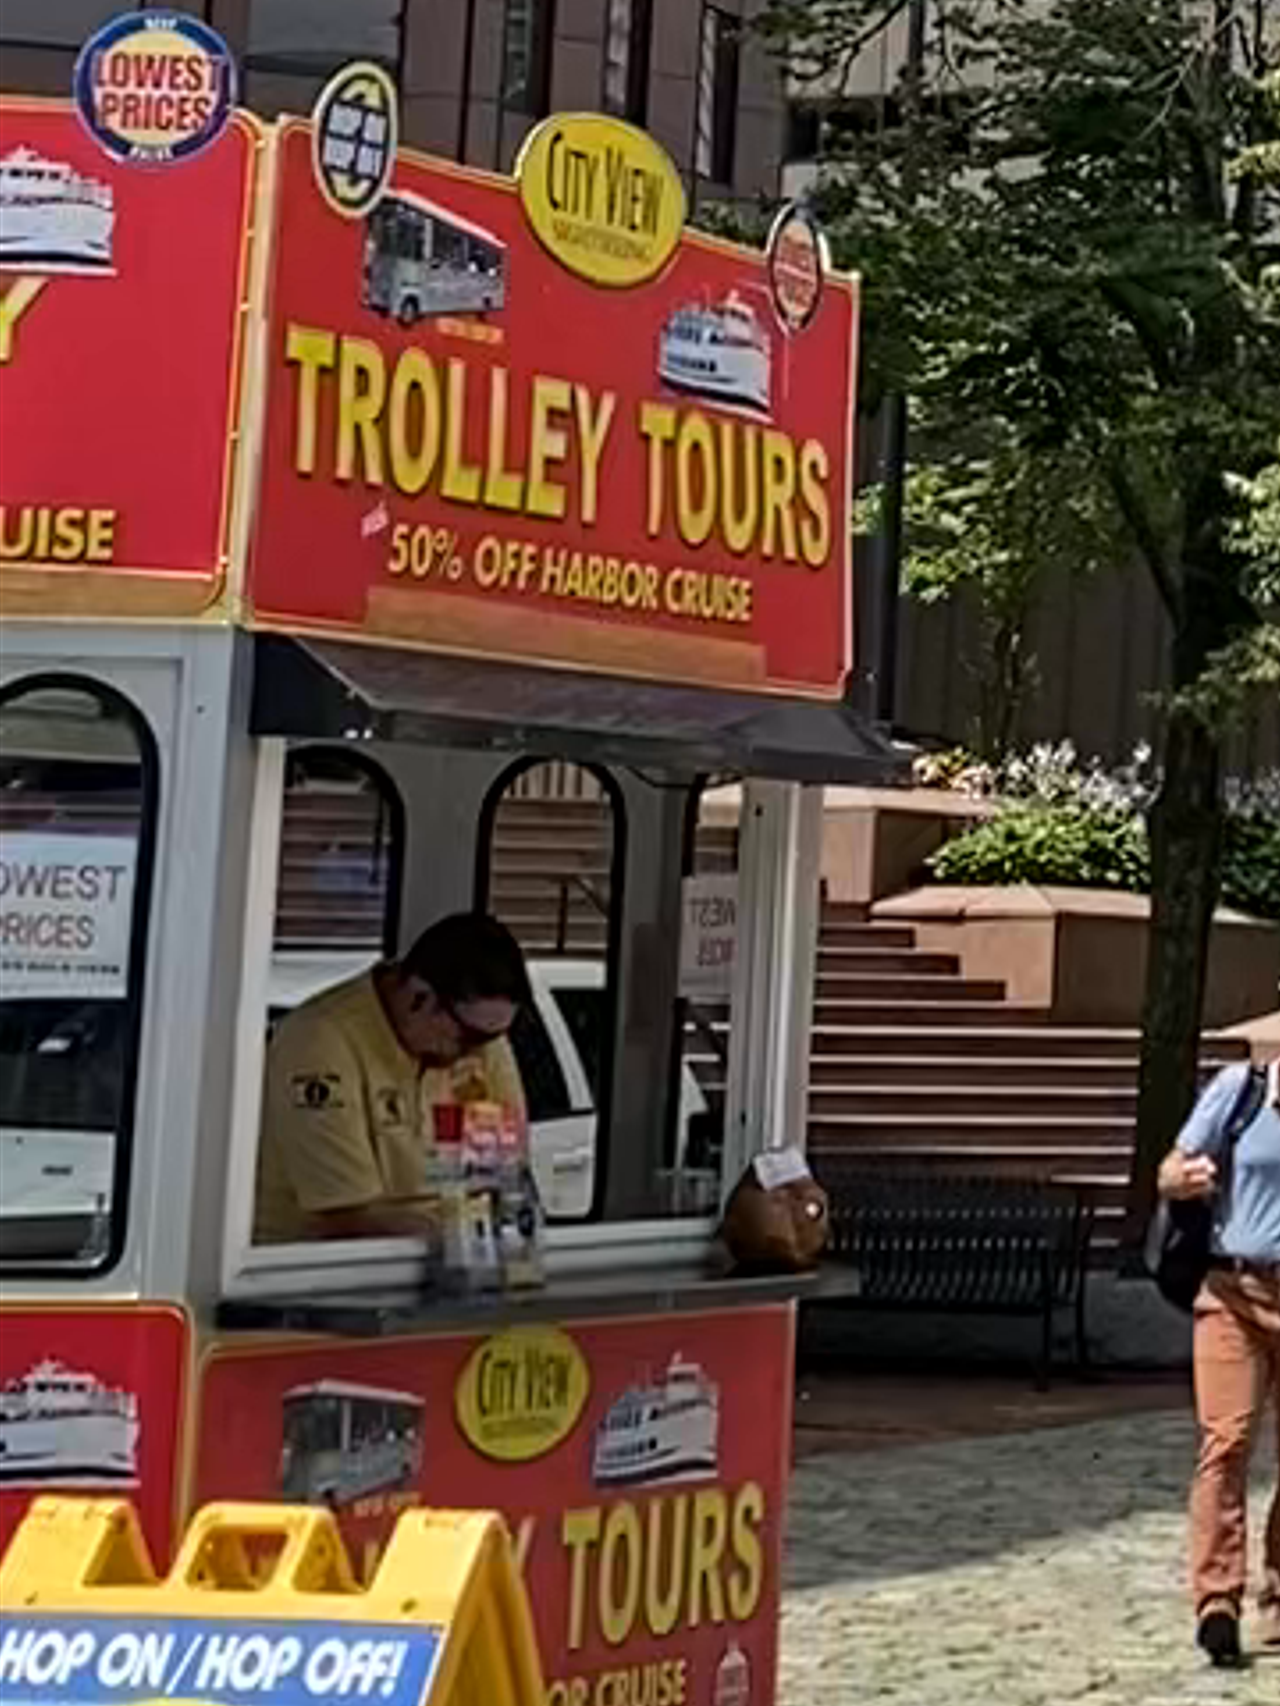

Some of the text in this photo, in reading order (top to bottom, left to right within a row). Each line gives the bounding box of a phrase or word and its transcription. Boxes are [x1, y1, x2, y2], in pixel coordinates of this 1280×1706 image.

[95, 51, 223, 92] LOWEST
[100, 93, 212, 132] PRICES
[284, 323, 831, 569] TROLLEY TOURS
[387, 523, 754, 622] 50% OFF HARBOR CRUISE
[563, 1482, 765, 1650] TOURS
[0, 1629, 96, 1685] HOP
[98, 1632, 175, 1687] ON
[194, 1635, 302, 1693] HOP
[304, 1639, 408, 1697] OFF!
